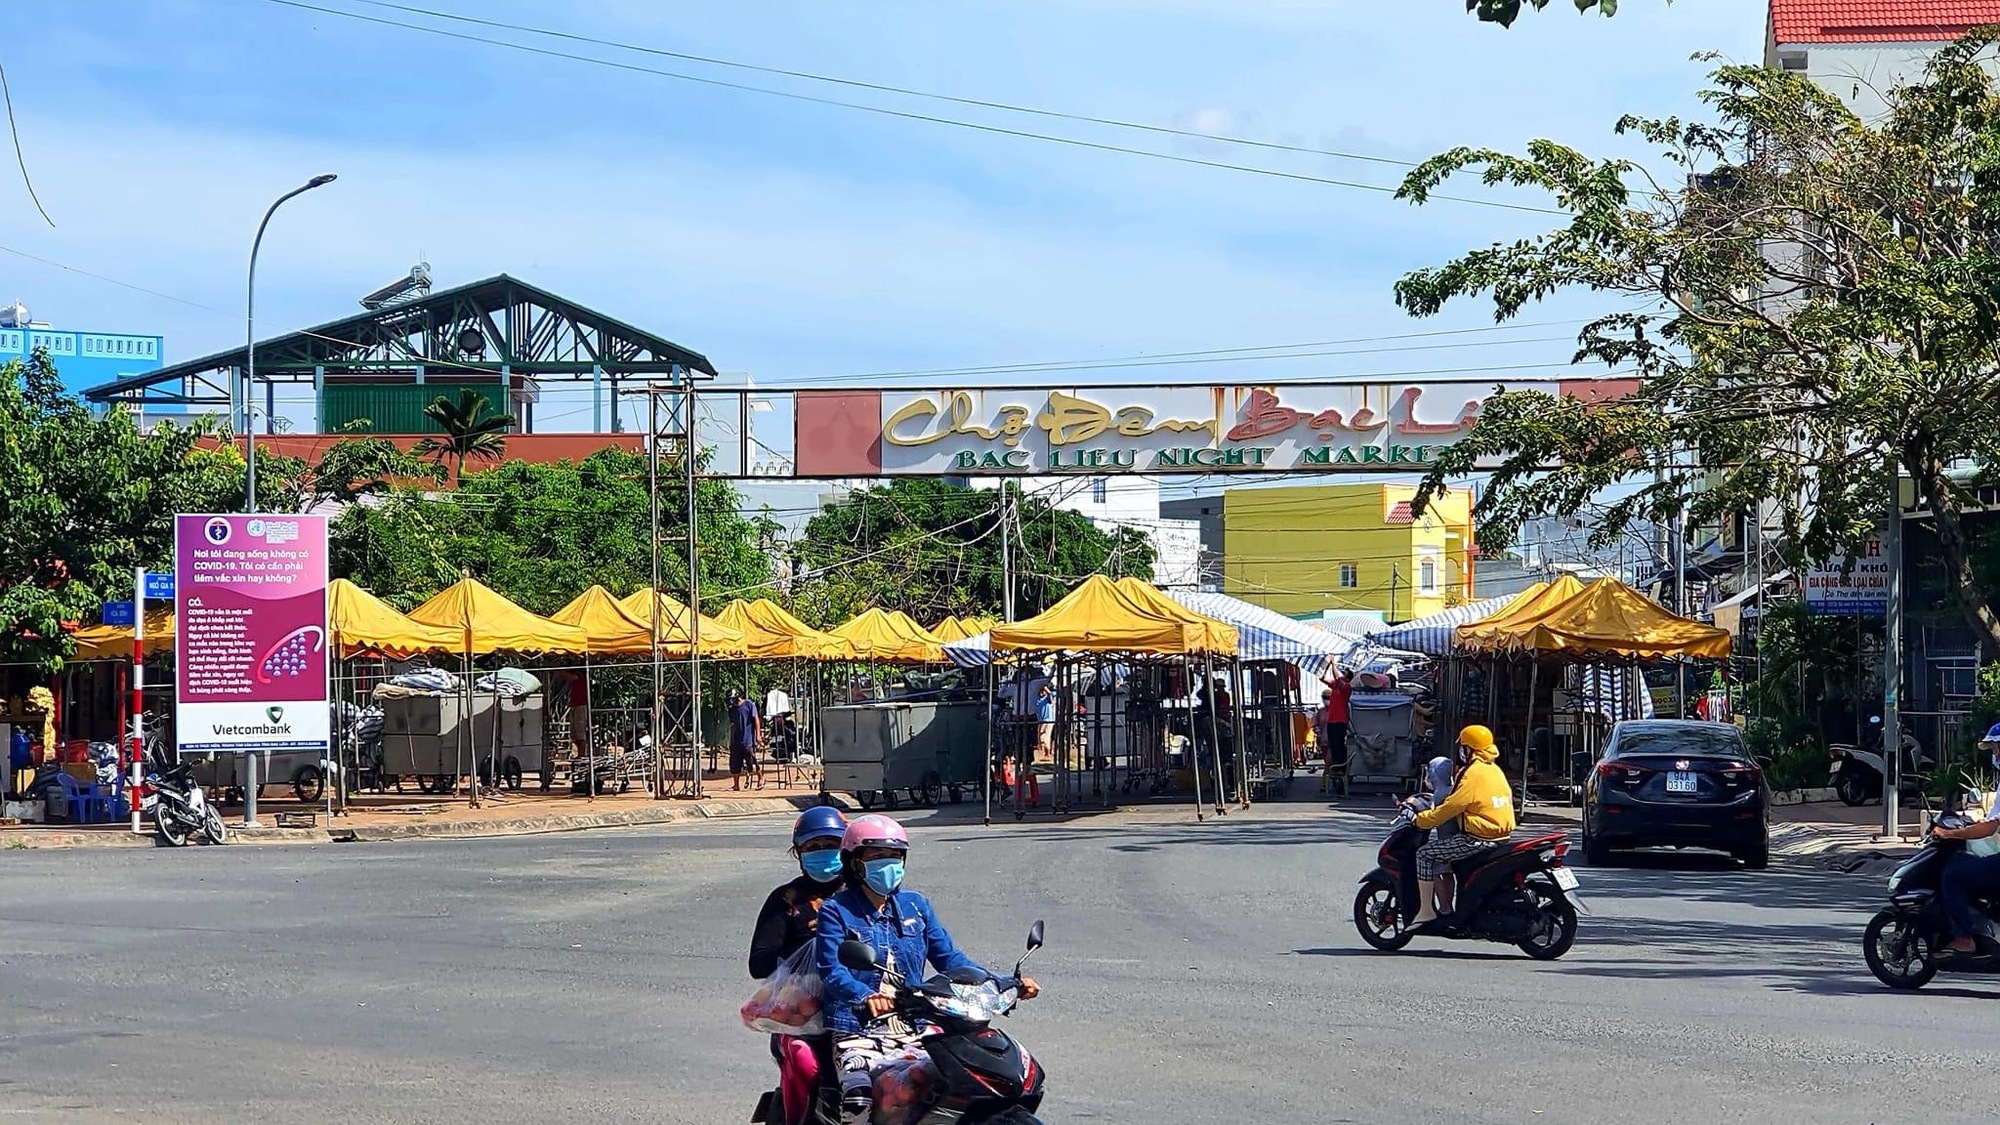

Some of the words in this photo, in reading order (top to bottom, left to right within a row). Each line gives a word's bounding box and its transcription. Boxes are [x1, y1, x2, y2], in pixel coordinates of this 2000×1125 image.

[883, 391, 1031, 446] Chợ
[1038, 391, 1219, 446] Đêm
[1227, 389, 1389, 442] Bạc
[955, 449, 1030, 471] BAC
[1050, 448, 1138, 470] LIEU
[1157, 447, 1275, 467] NIGHT
[213, 723, 292, 735] Vietcombank
[1674, 772, 1690, 781] 94A
[1668, 781, 1696, 791] 03160
